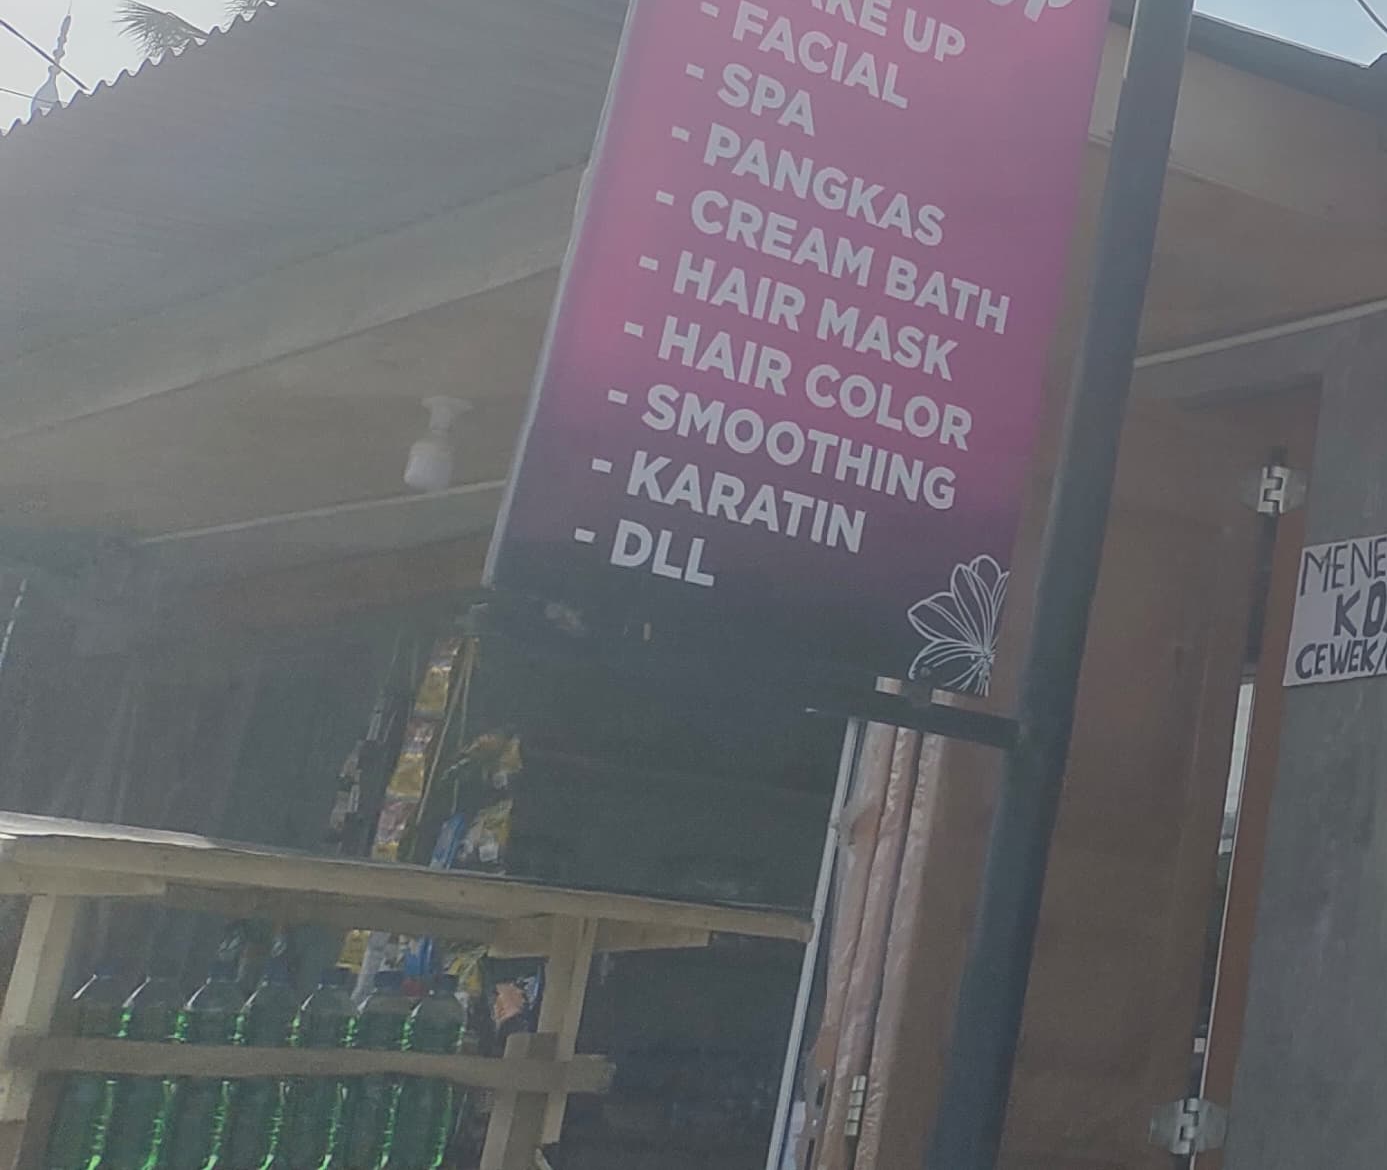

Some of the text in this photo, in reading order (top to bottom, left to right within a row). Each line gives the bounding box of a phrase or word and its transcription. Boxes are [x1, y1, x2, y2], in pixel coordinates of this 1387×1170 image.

[732, 0, 909, 110] FACIAL
[902, 8, 966, 62] UP
[716, 62, 815, 137] SPA
[702, 121, 947, 247] PANGKAS
[672, 250, 806, 332] HAIR
[815, 297, 959, 382] MASK
[690, 188, 875, 288] CREAM
[884, 255, 1011, 335] BATH
[656, 315, 793, 397] HAIR
[804, 363, 974, 452] COLOR
[625, 449, 866, 555] KARATIN
[640, 383, 957, 511] SMOOTHING
[609, 518, 716, 588] DLL
